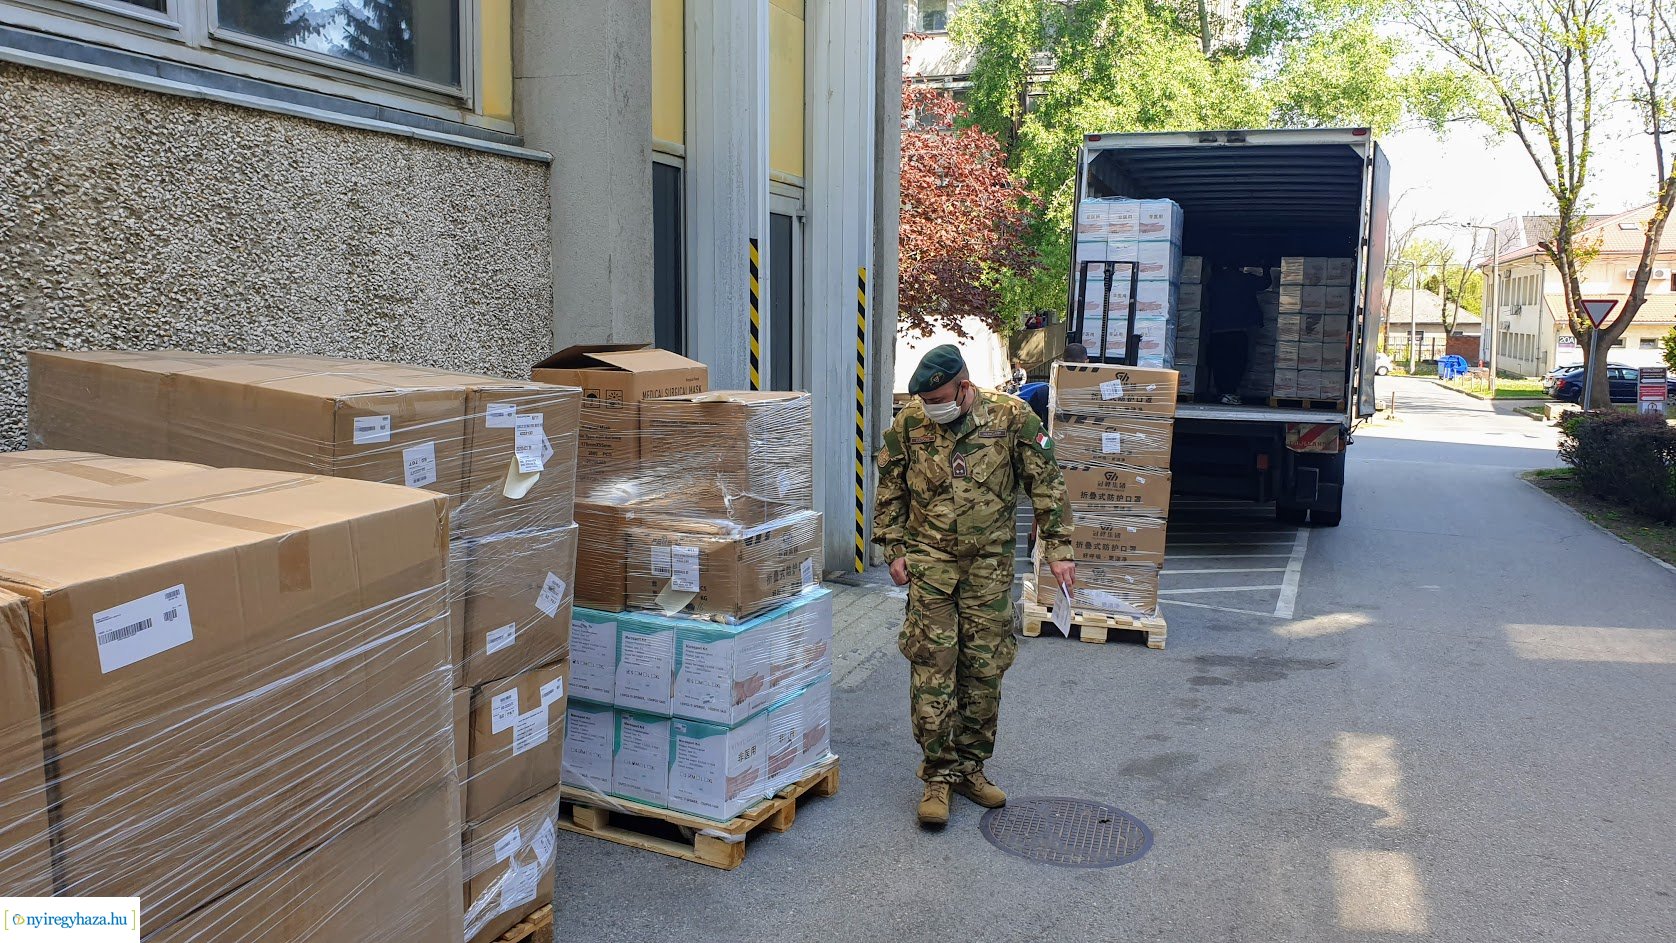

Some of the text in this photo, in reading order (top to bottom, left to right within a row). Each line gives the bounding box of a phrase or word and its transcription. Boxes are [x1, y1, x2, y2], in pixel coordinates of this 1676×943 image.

[1559, 336, 1575, 345] 20A
[688, 384, 703, 394] MASK
[737, 744, 757, 763] 非医用
